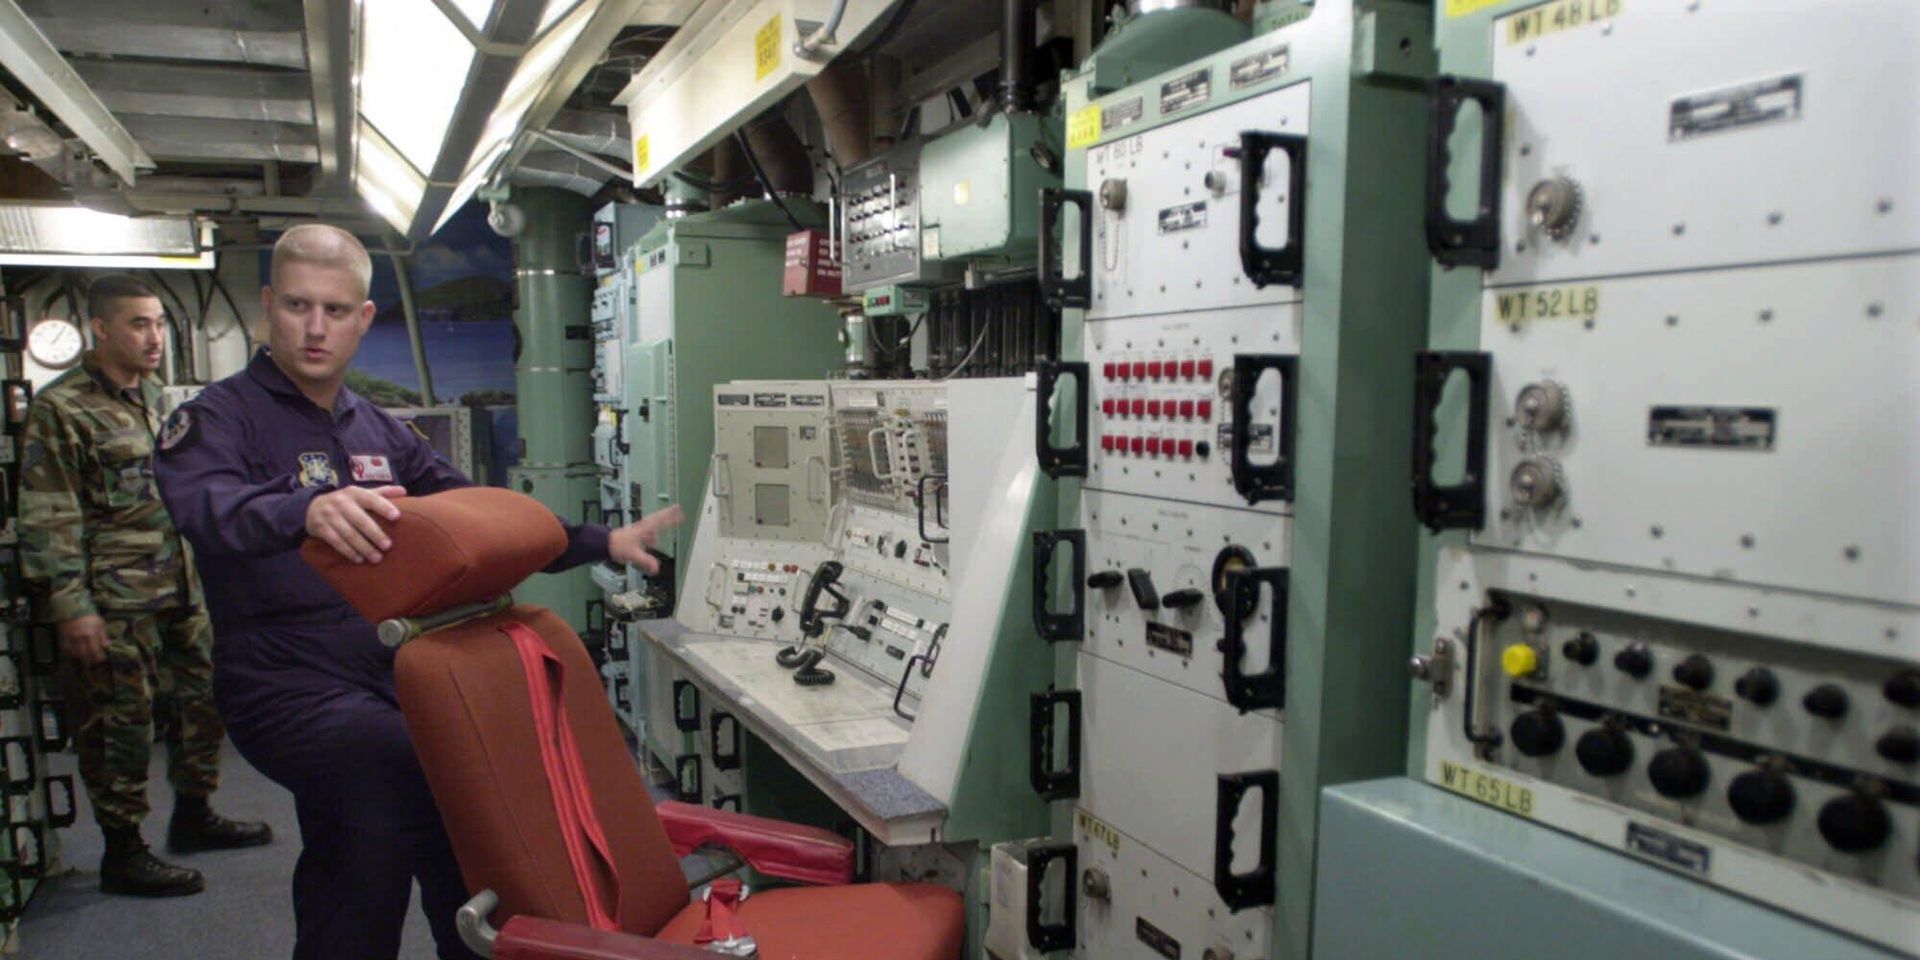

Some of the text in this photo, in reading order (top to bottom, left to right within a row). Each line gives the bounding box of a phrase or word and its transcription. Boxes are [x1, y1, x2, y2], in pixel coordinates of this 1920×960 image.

[1513, 9, 1544, 41] WT
[1589, 0, 1619, 21] LB
[1497, 286, 1598, 319] WT 52 LB
[1442, 761, 1533, 813] WT 65 LB
